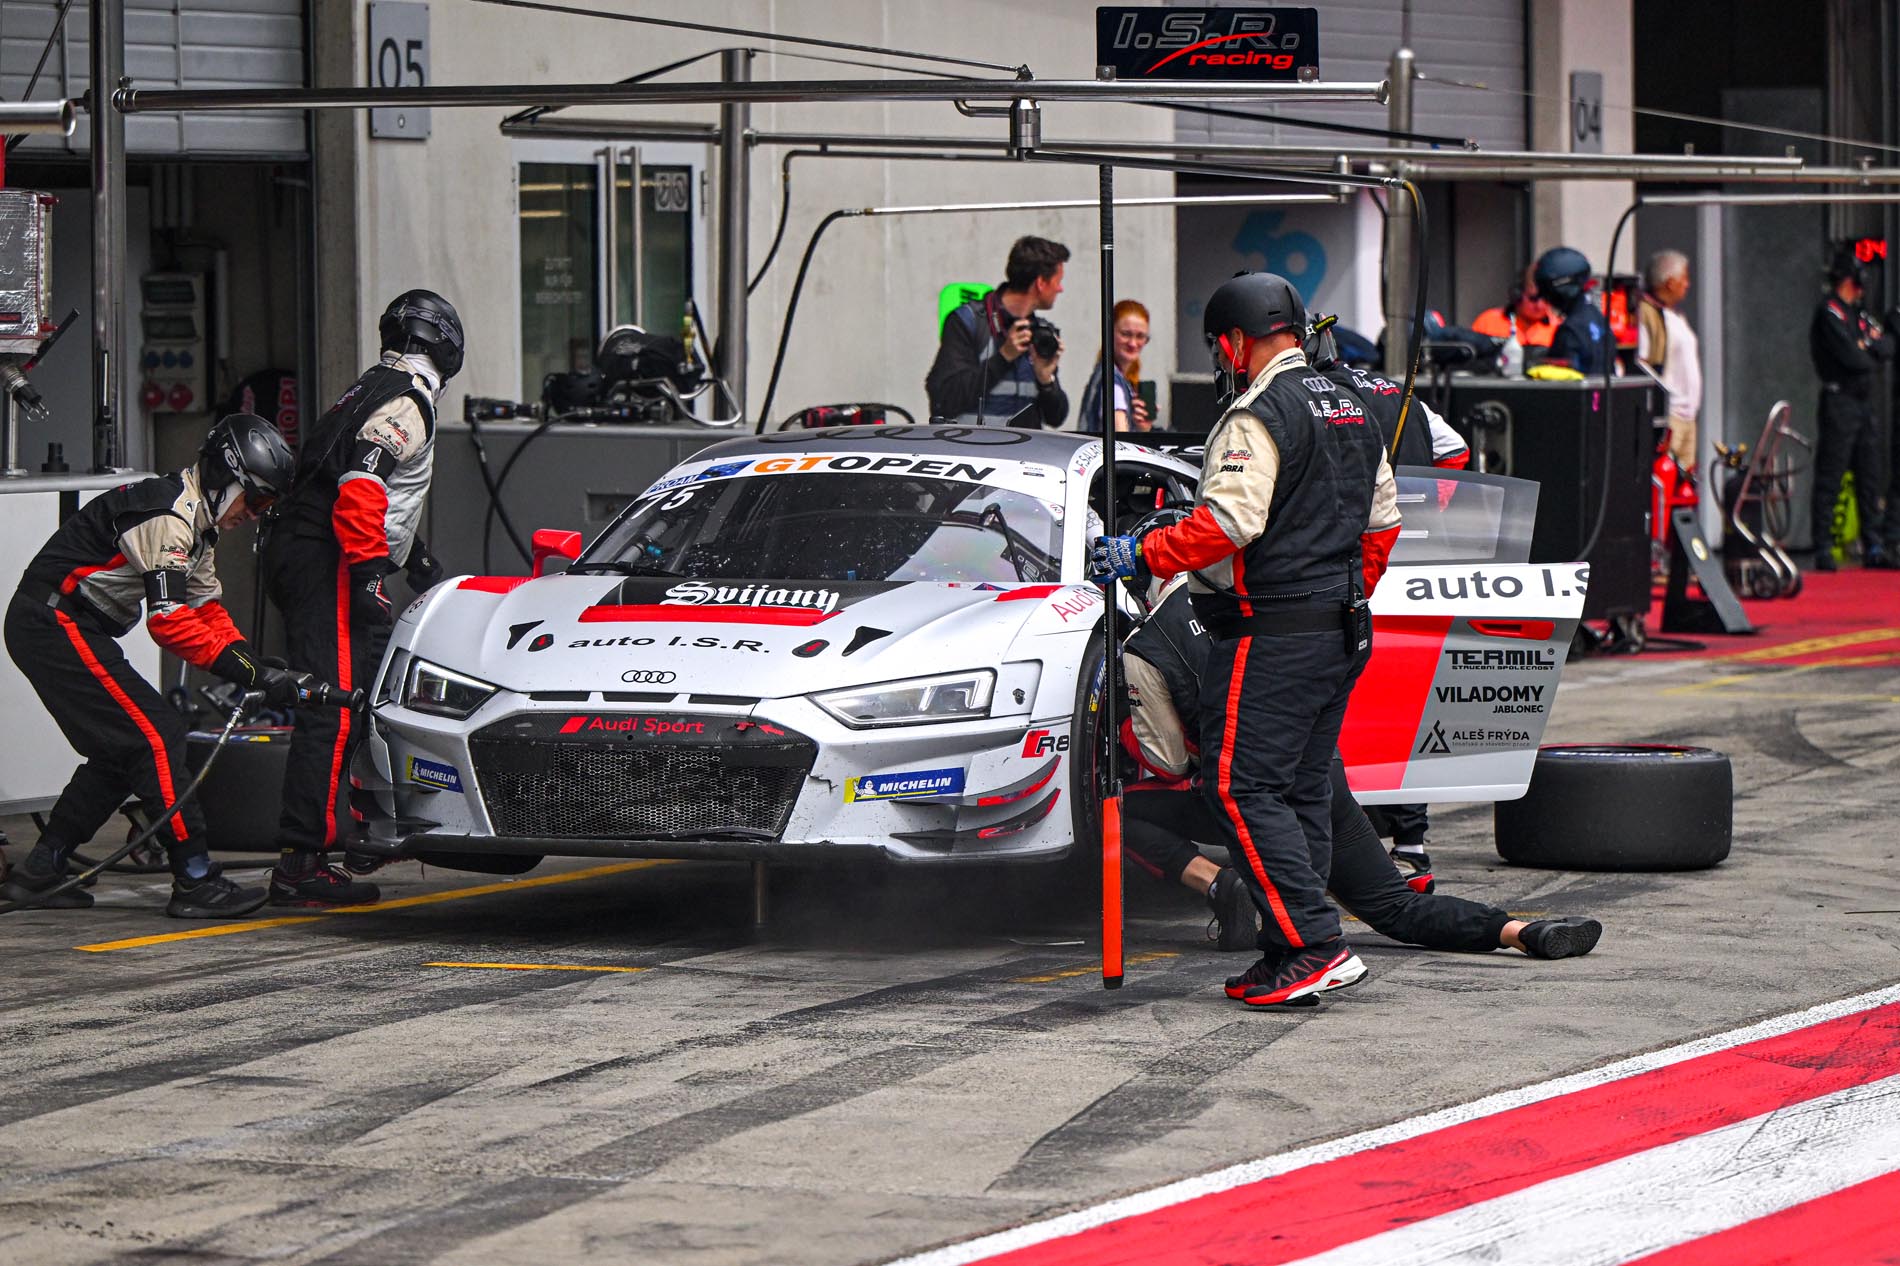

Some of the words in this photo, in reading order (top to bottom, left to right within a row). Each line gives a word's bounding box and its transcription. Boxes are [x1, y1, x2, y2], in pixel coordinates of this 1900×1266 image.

[378, 38, 424, 88] 05
[1188, 51, 1294, 70] racing
[363, 446, 382, 473] 4
[754, 457, 834, 473] GT
[828, 456, 996, 481] OPEN
[631, 484, 704, 519] 75
[156, 571, 168, 599] 1
[1406, 570, 1524, 600] auto
[1051, 586, 1095, 623] Audi
[568, 636, 656, 649] auto
[668, 636, 770, 654] I.S.R.
[1435, 686, 1544, 703] VILADOMY
[1493, 705, 1544, 714] JABLONEC
[588, 716, 638, 731] Audi
[643, 717, 705, 734] Sport
[1035, 734, 1070, 754] R8
[1452, 729, 1484, 741] ALEŠ
[1487, 729, 1530, 741] FRÝDA
[420, 768, 457, 784] MICHELIN
[879, 777, 951, 793] MICHELIN
